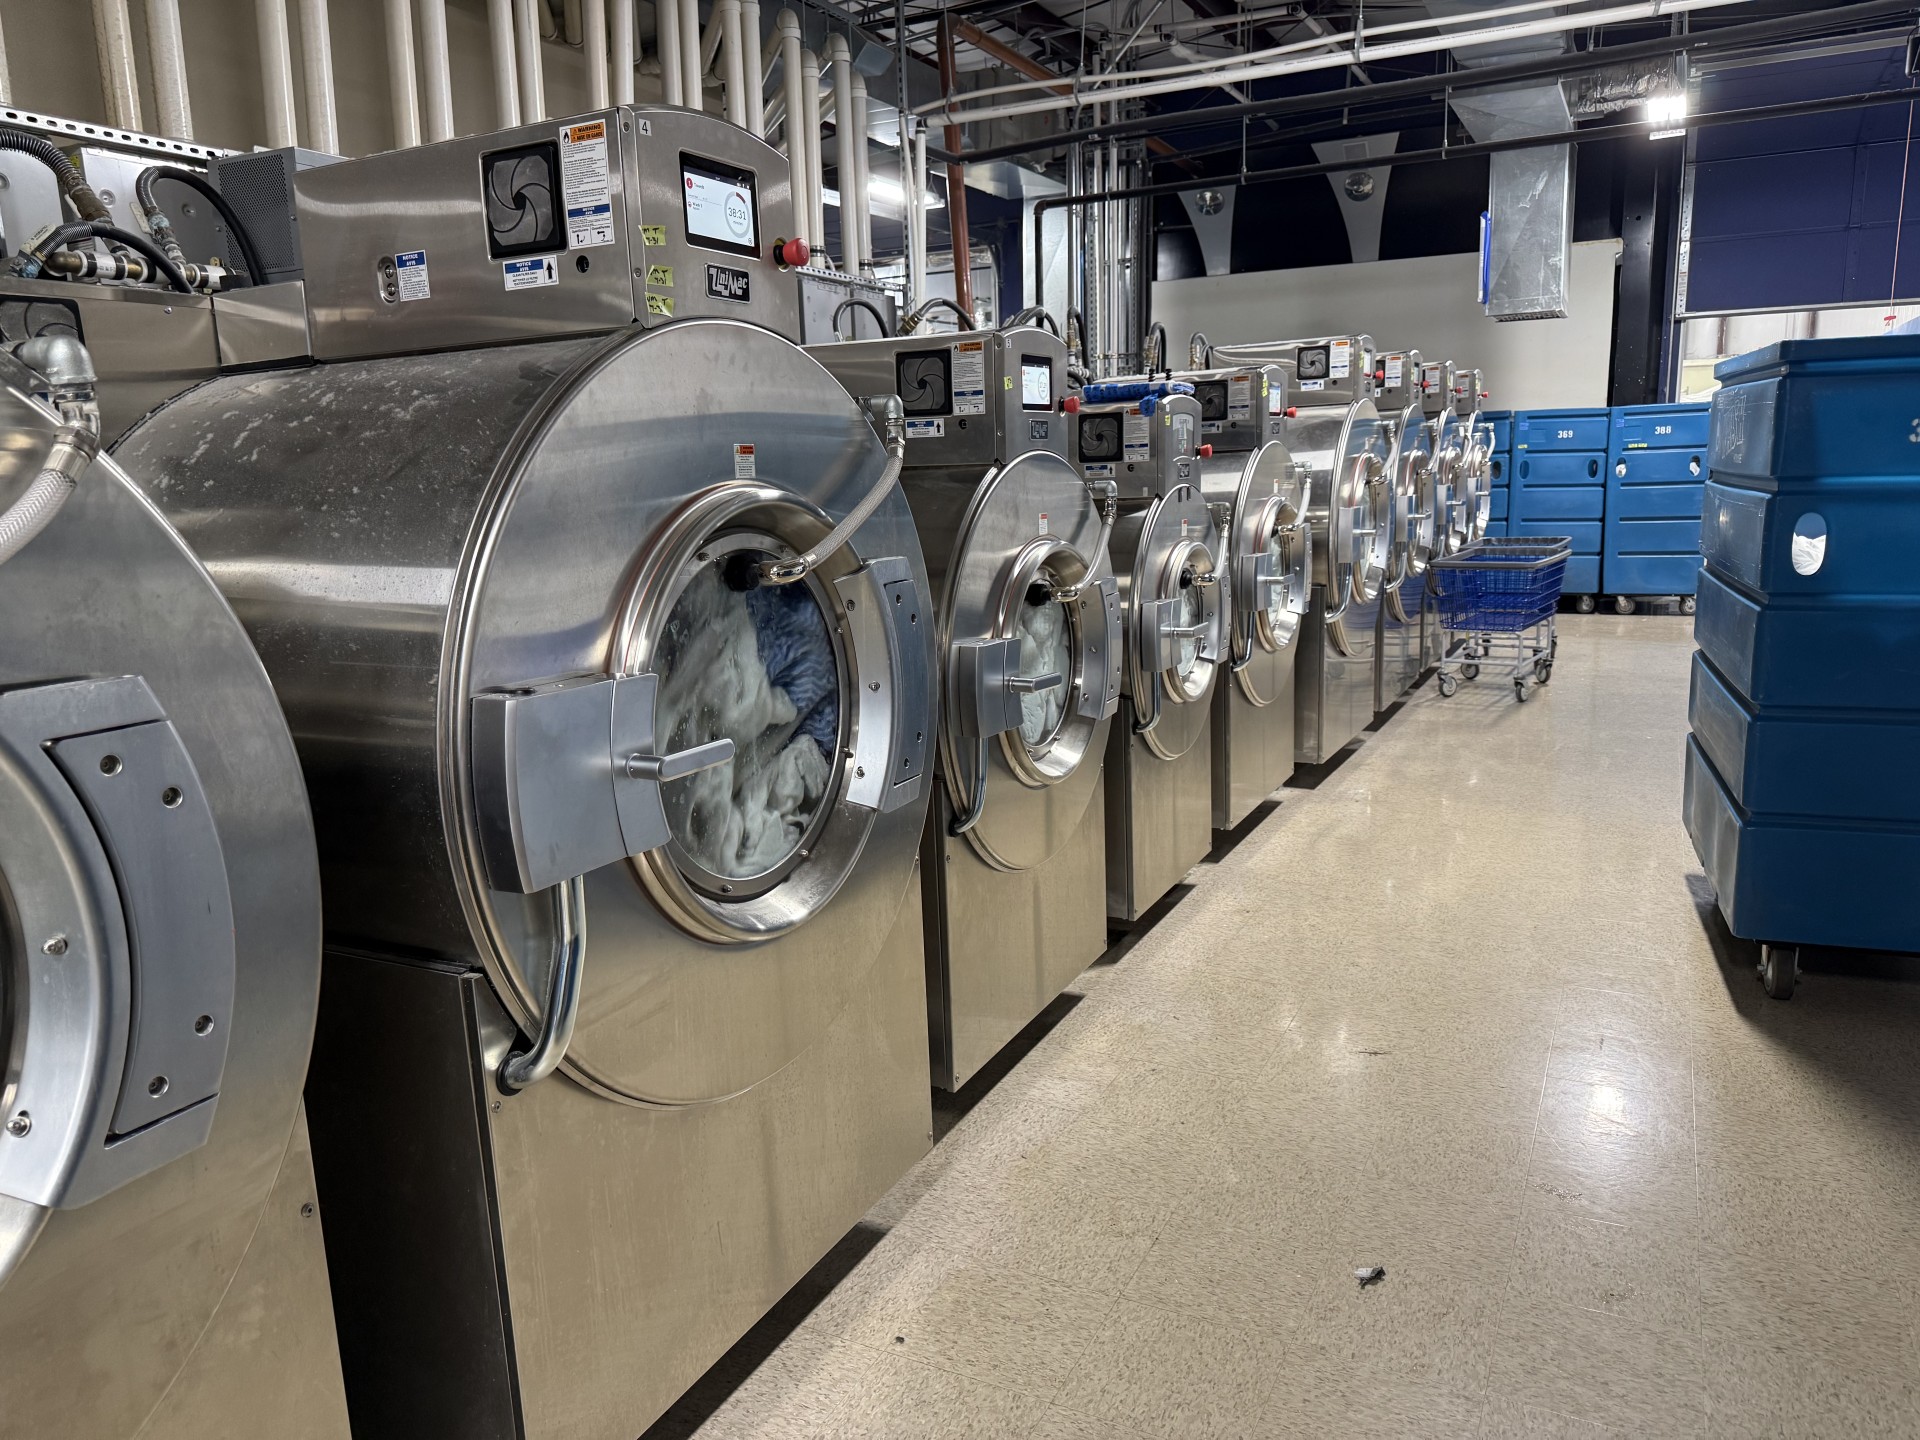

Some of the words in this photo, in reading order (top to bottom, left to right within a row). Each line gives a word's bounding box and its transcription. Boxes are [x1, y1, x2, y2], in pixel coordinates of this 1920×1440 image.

[642, 121, 648, 134] 4
[728, 207, 746, 220] 38:31
[708, 267, 748, 297] UniMac
[1557, 430, 1573, 439] 369
[1654, 425, 1672, 435] 388
